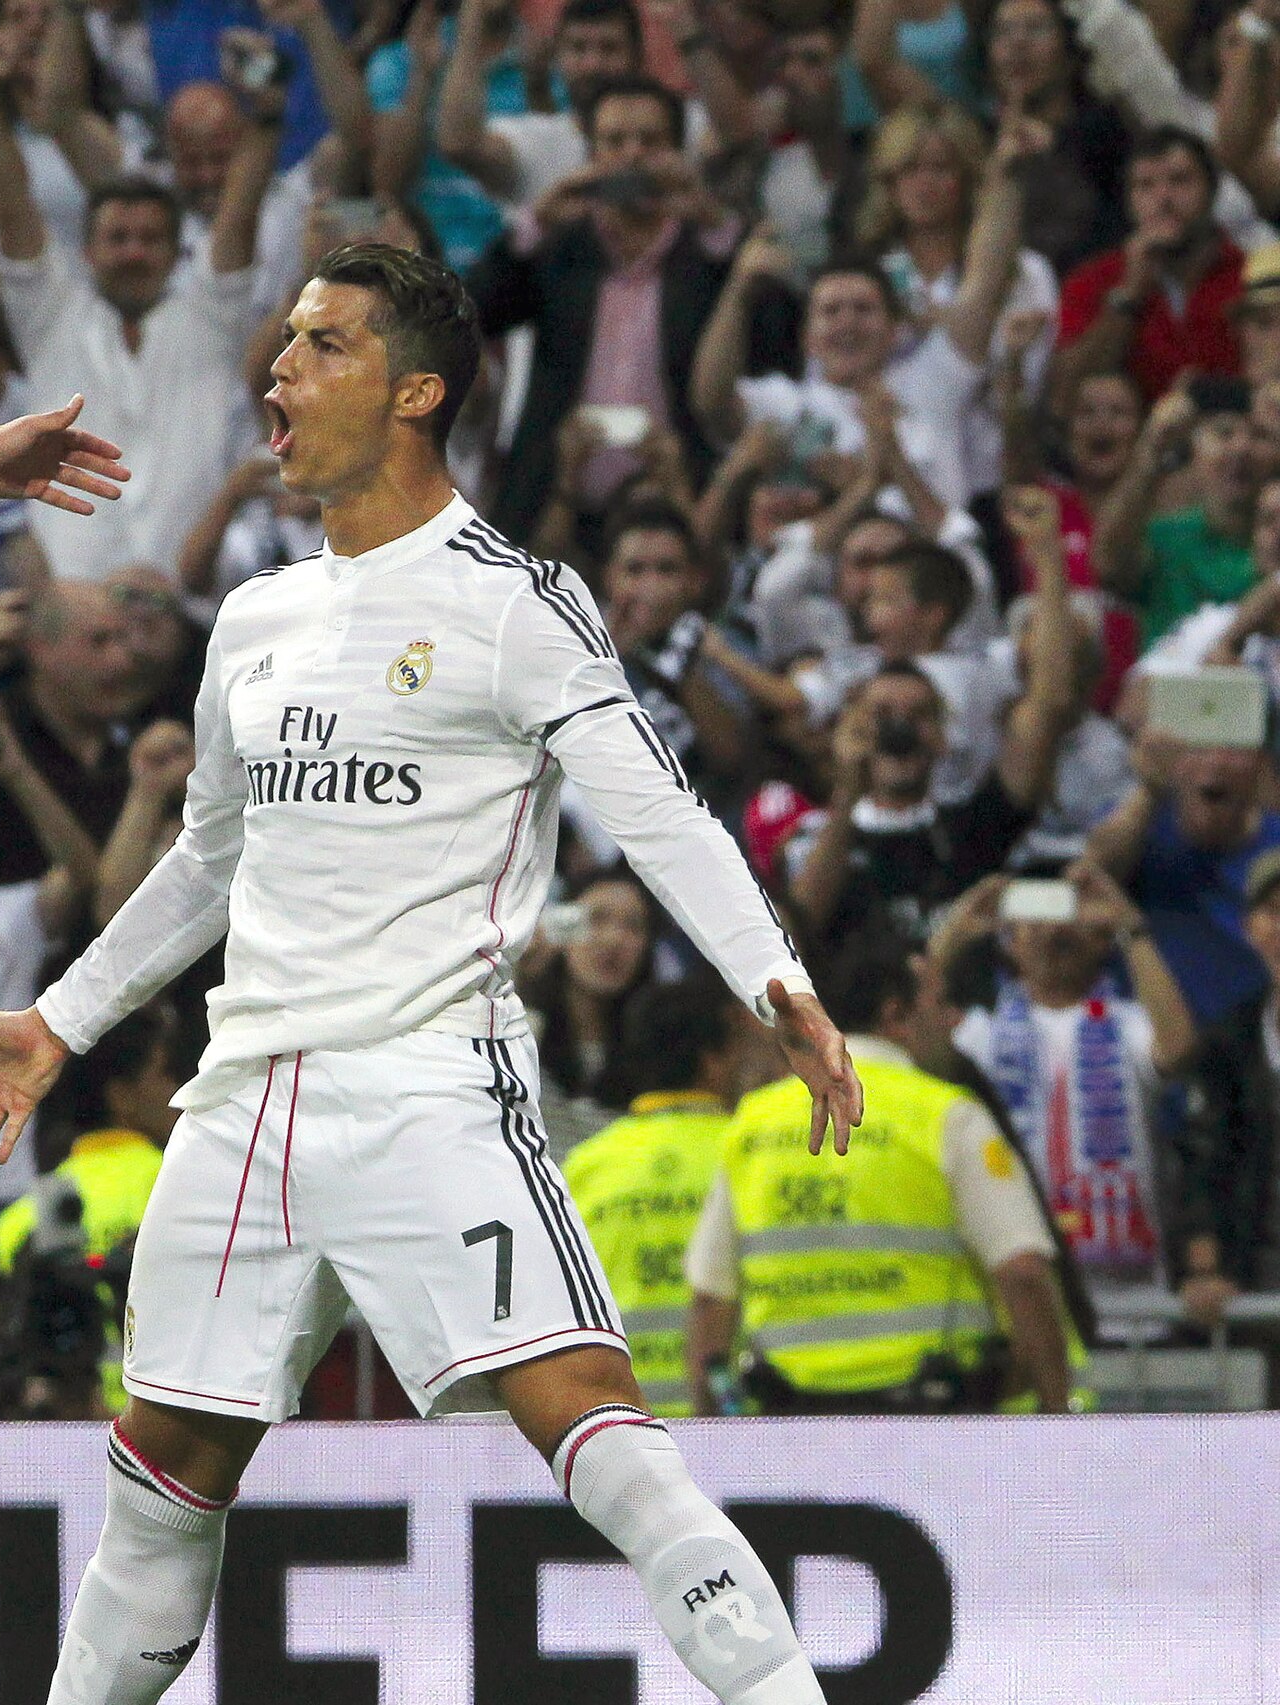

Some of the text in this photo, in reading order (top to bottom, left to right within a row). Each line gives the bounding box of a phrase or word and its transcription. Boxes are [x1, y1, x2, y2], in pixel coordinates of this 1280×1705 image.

[279, 706, 338, 750] Fly
[239, 747, 423, 806] mirates
[461, 1219, 514, 1322] 7
[682, 1568, 737, 1614] RM
